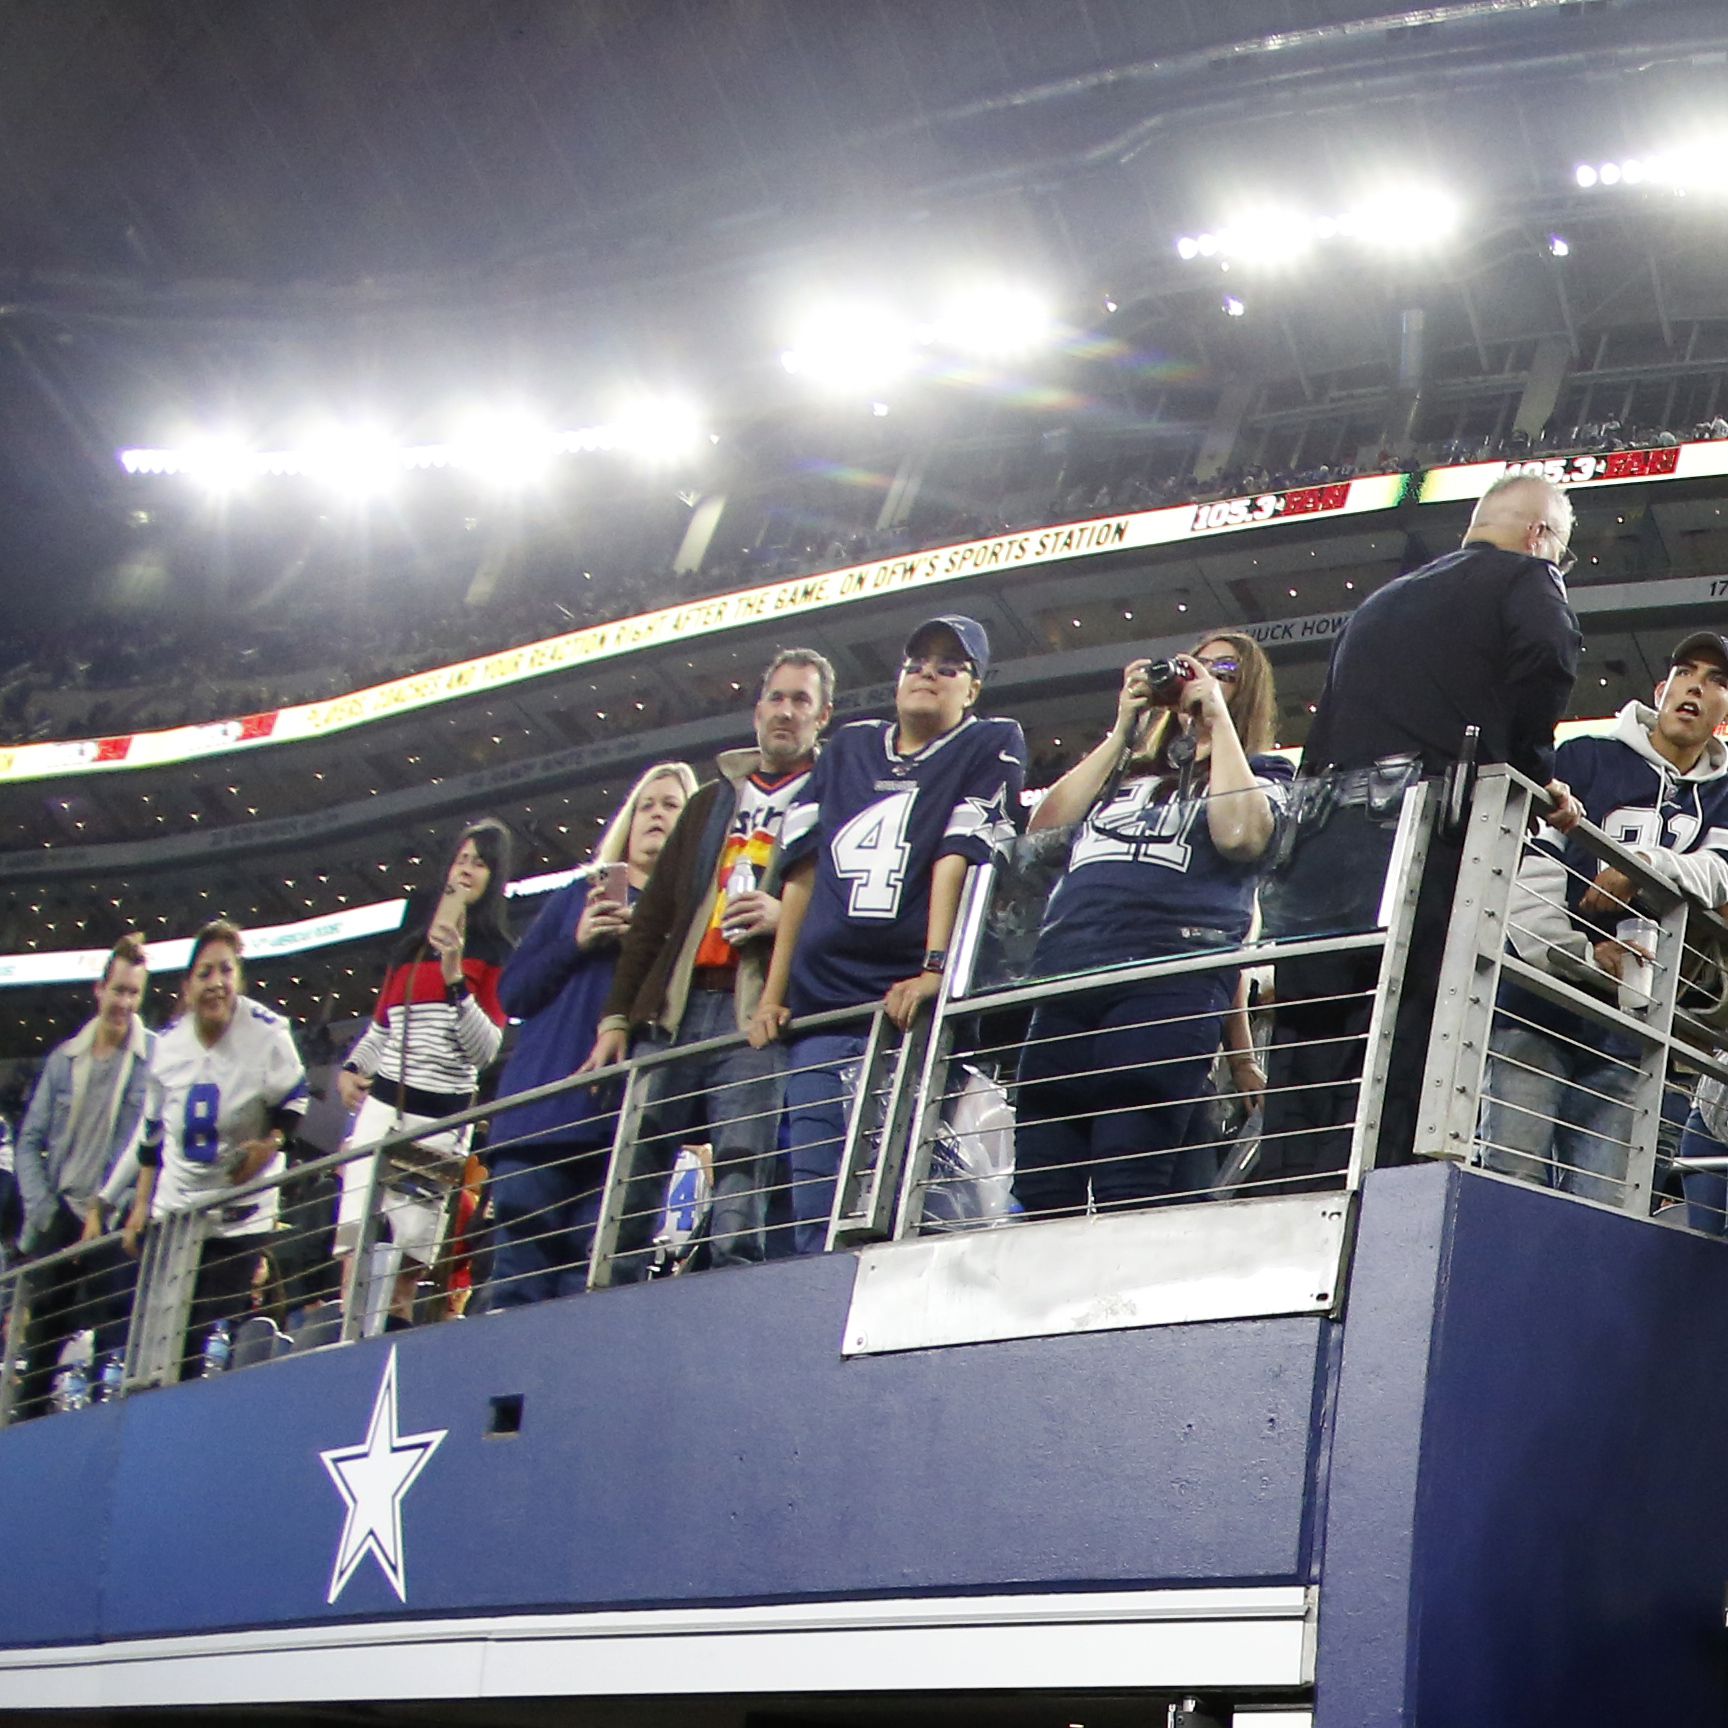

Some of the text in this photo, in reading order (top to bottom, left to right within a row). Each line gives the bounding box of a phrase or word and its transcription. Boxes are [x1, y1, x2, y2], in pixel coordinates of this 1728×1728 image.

[1192, 495, 1278, 531] 105.3
[673, 600, 726, 636] AFTER
[735, 592, 767, 620] THE
[840, 572, 867, 595] ON
[874, 556, 940, 589] DFW'S
[944, 538, 1029, 573] SPORTS
[1034, 520, 1130, 558] STATION
[1236, 623, 1293, 644] HUCK
[830, 786, 920, 919] 4
[182, 1082, 221, 1163] 8
